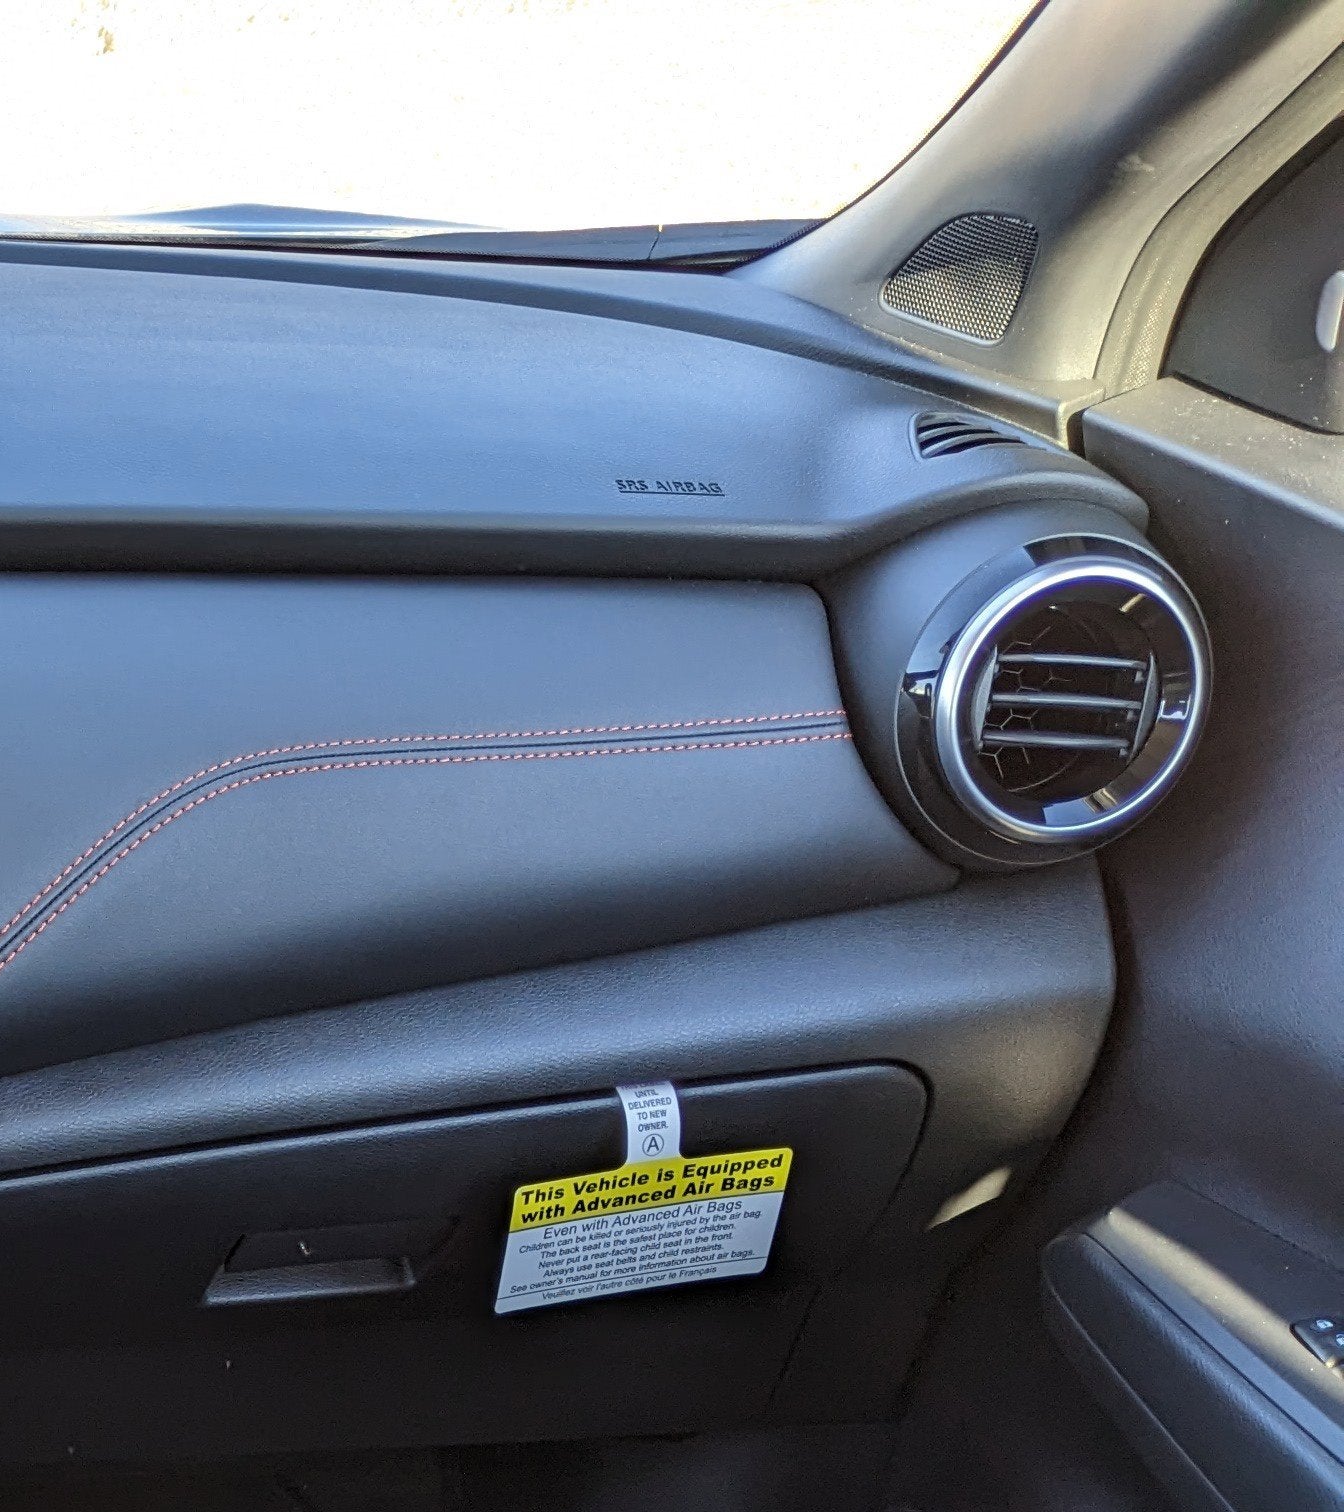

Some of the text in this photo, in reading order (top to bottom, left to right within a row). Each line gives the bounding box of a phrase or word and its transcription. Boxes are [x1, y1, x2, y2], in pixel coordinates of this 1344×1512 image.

[615, 479, 722, 494] SRS AIRBAG
[628, 1097, 672, 1110] DELIVERED
[634, 1089, 659, 1098] UNTIL
[637, 1110, 667, 1120] TO NEW
[521, 1153, 785, 1205] This Vehicle is Equipped
[521, 1175, 775, 1224] with Advanced Air Bags
[519, 1211, 740, 1254] Children can be killed or seriously injured by the air
[543, 1200, 742, 1239] Even with Advanced Air Bags
[538, 1259, 564, 1269] Never
[566, 1255, 581, 1267] put
[640, 1242, 660, 1252] child
[663, 1239, 682, 1248] seat
[695, 1235, 709, 1243] the
[540, 1251, 556, 1259] The
[559, 1247, 579, 1256] back
[582, 1243, 601, 1252] seat
[613, 1237, 627, 1246] the
[629, 1233, 656, 1244] safest
[658, 1229, 682, 1240] place
[684, 1227, 696, 1235] for
[510, 1285, 527, 1293] See
[566, 1271, 597, 1283] manual
[600, 1269, 612, 1277] for
[614, 1265, 637, 1274] more
[690, 1254, 715, 1263] about
[717, 1251, 729, 1259] air
[543, 1266, 574, 1278] Always
[595, 1260, 614, 1268] seat
[639, 1252, 655, 1262] and
[658, 1249, 679, 1259] child
